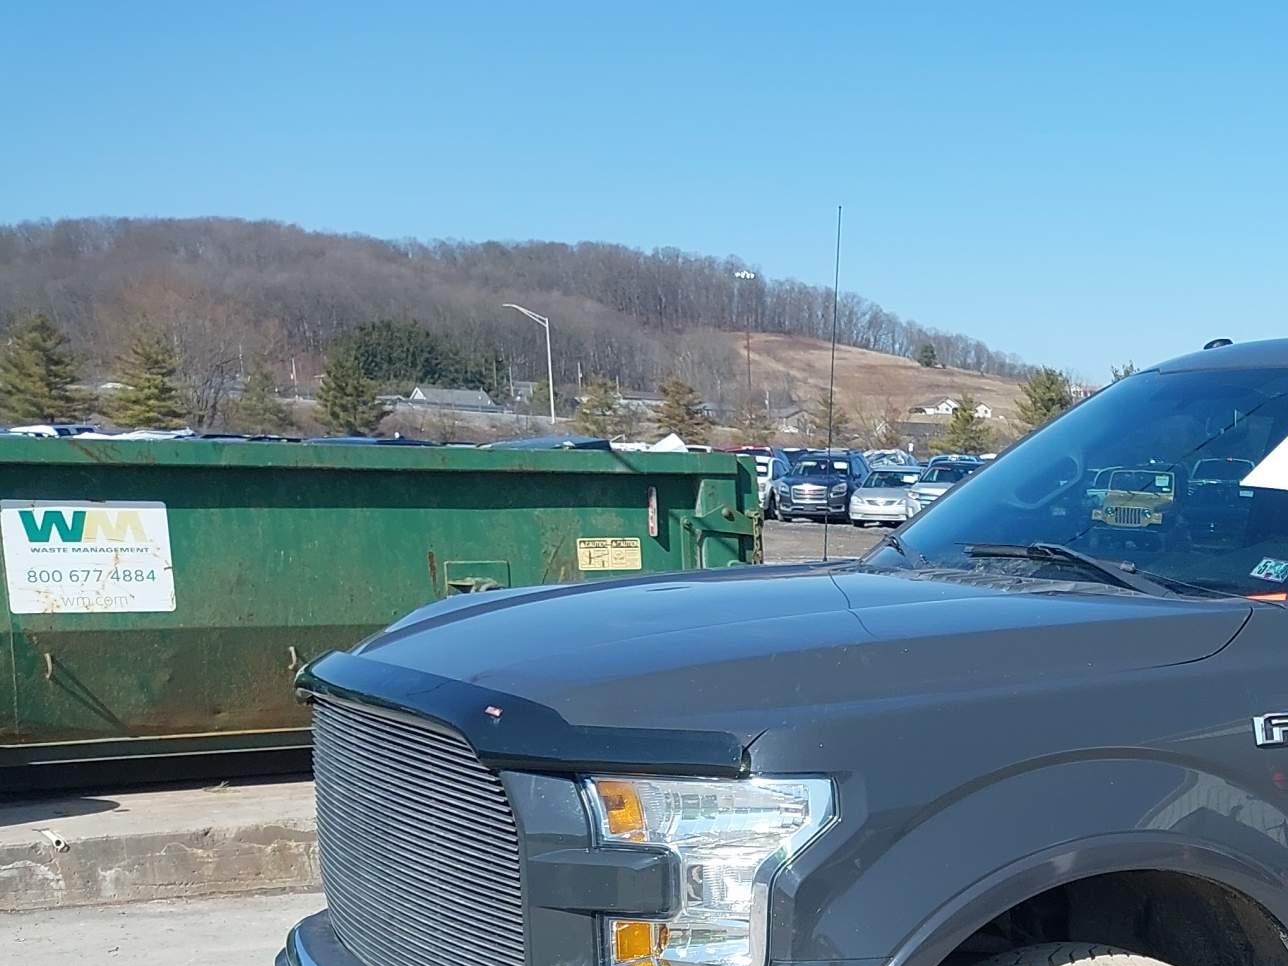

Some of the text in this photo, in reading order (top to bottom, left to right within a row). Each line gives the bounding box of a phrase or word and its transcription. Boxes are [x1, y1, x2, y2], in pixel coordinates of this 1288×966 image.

[18, 510, 148, 543] WM
[27, 568, 156, 583] 800 677 4884
[62, 594, 129, 608] wm.com
